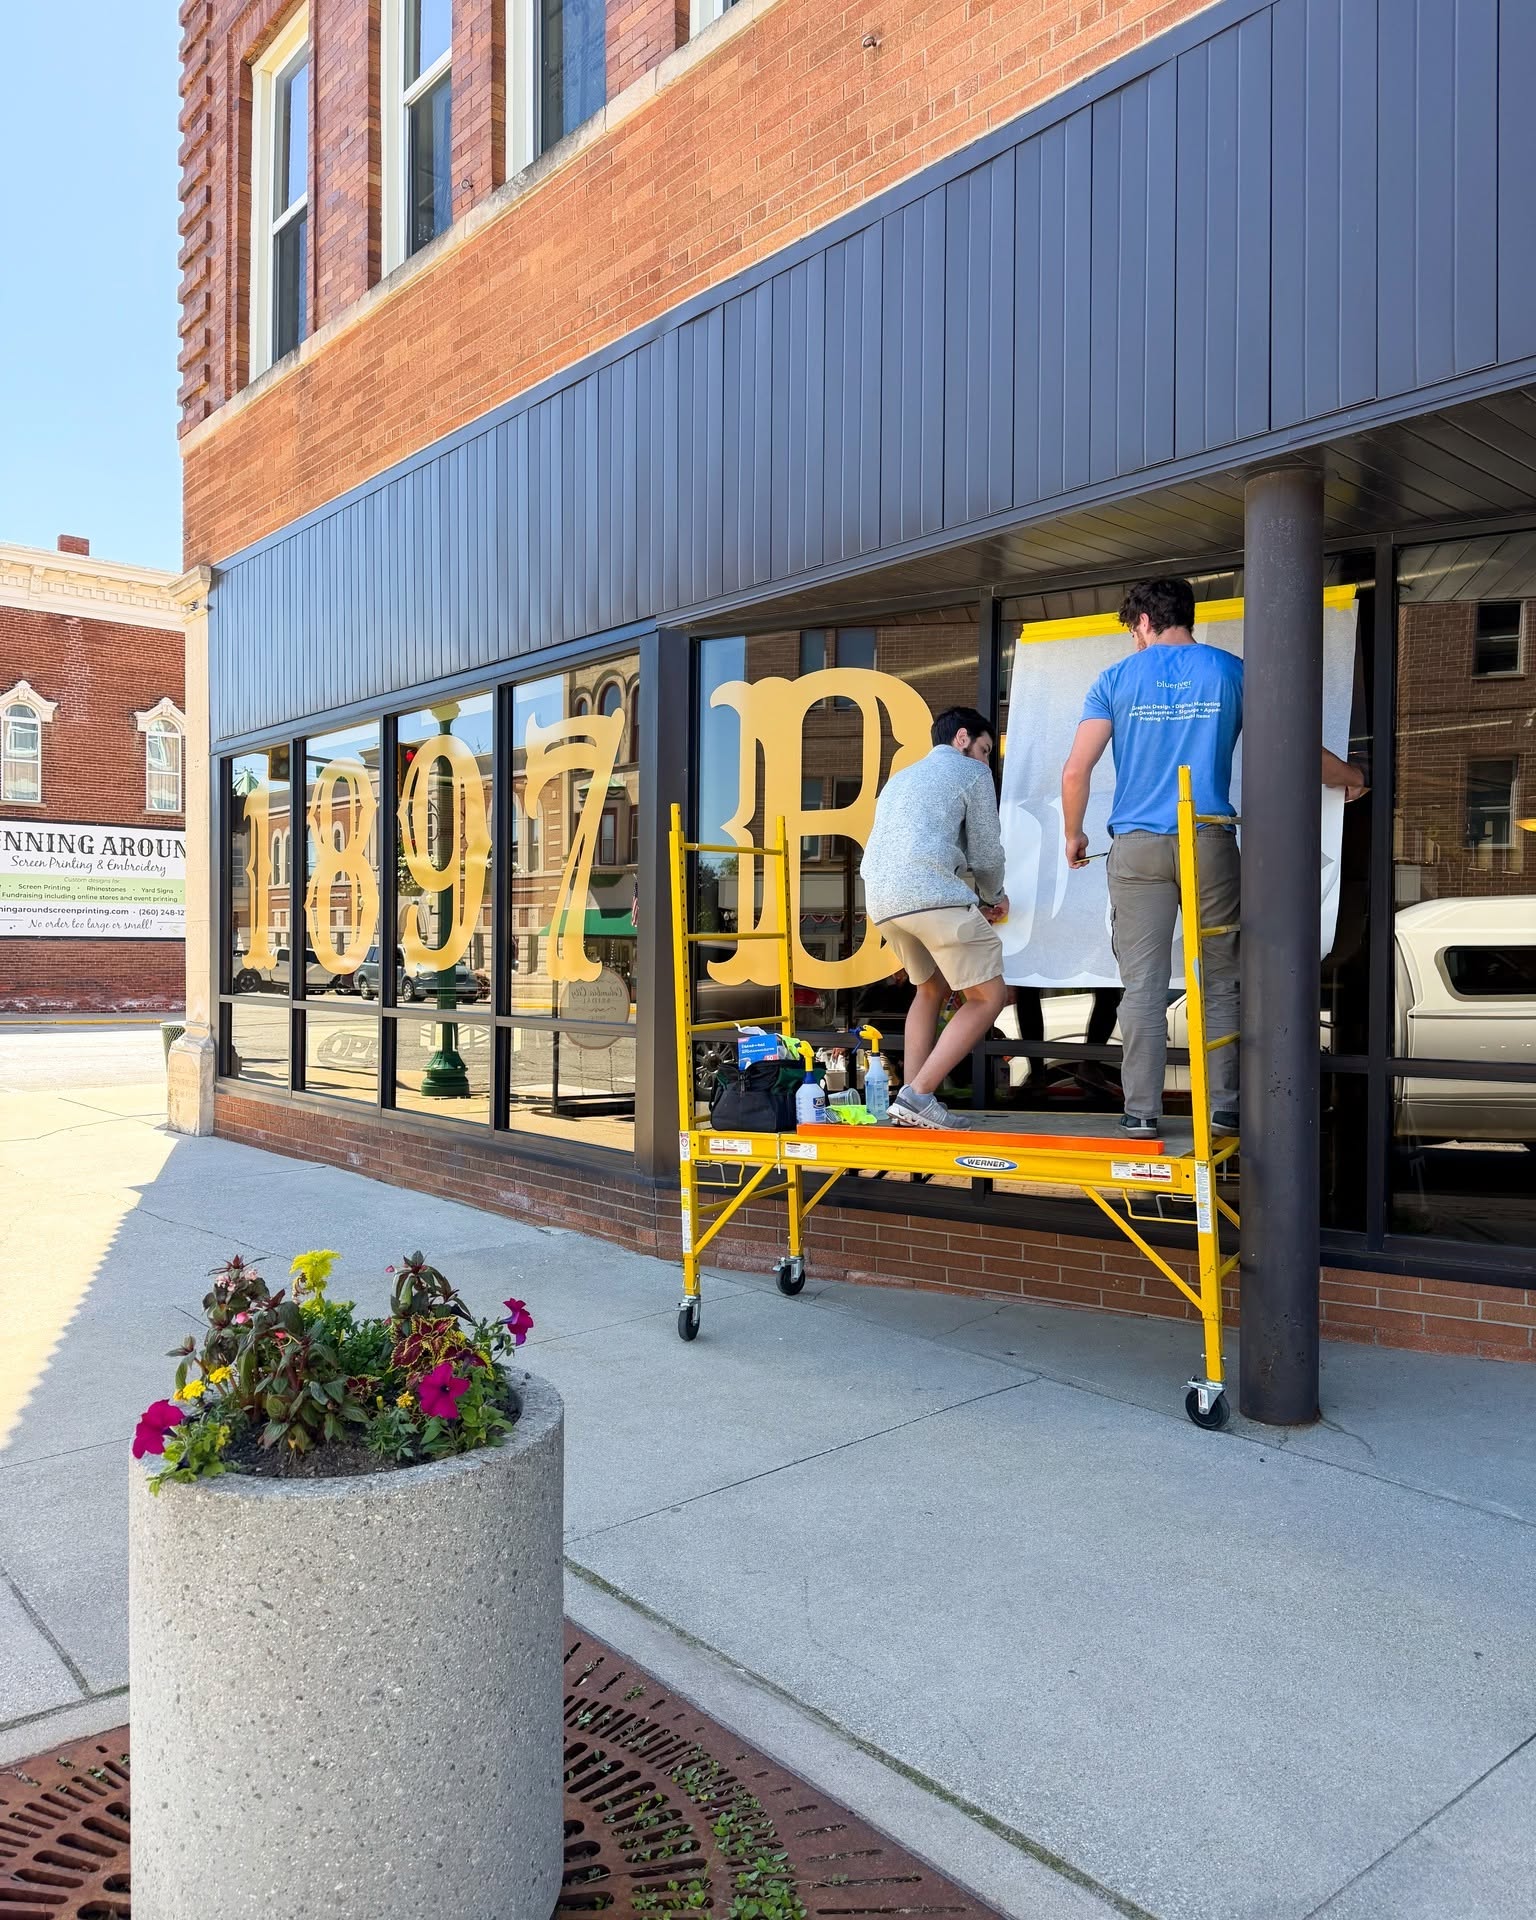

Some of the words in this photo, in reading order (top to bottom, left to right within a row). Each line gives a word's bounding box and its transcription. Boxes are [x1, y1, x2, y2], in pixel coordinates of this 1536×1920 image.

[1156, 680, 1191, 689] blueriver
[0, 830, 94, 855] NNING
[100, 836, 186, 859] AROUN
[243, 707, 625, 984] 1897
[10, 855, 47, 868] Screen
[49, 857, 93, 874] Printing
[96, 860, 104, 870] &
[107, 858, 166, 877] Embroidery
[88, 877, 111, 885] designs
[44, 884, 71, 892] Printing
[2, 892, 43, 900] Fundraising
[44, 893, 76, 901] including
[139, 908, 159, 916] (260)
[28, 919, 43, 928] No
[45, 918, 70, 929] order
[72, 919, 85, 929] too
[87, 918, 110, 933] large
[112, 922, 123, 930] or
[124, 918, 152, 930] small!
[967, 1158, 1006, 1168] WERNER
